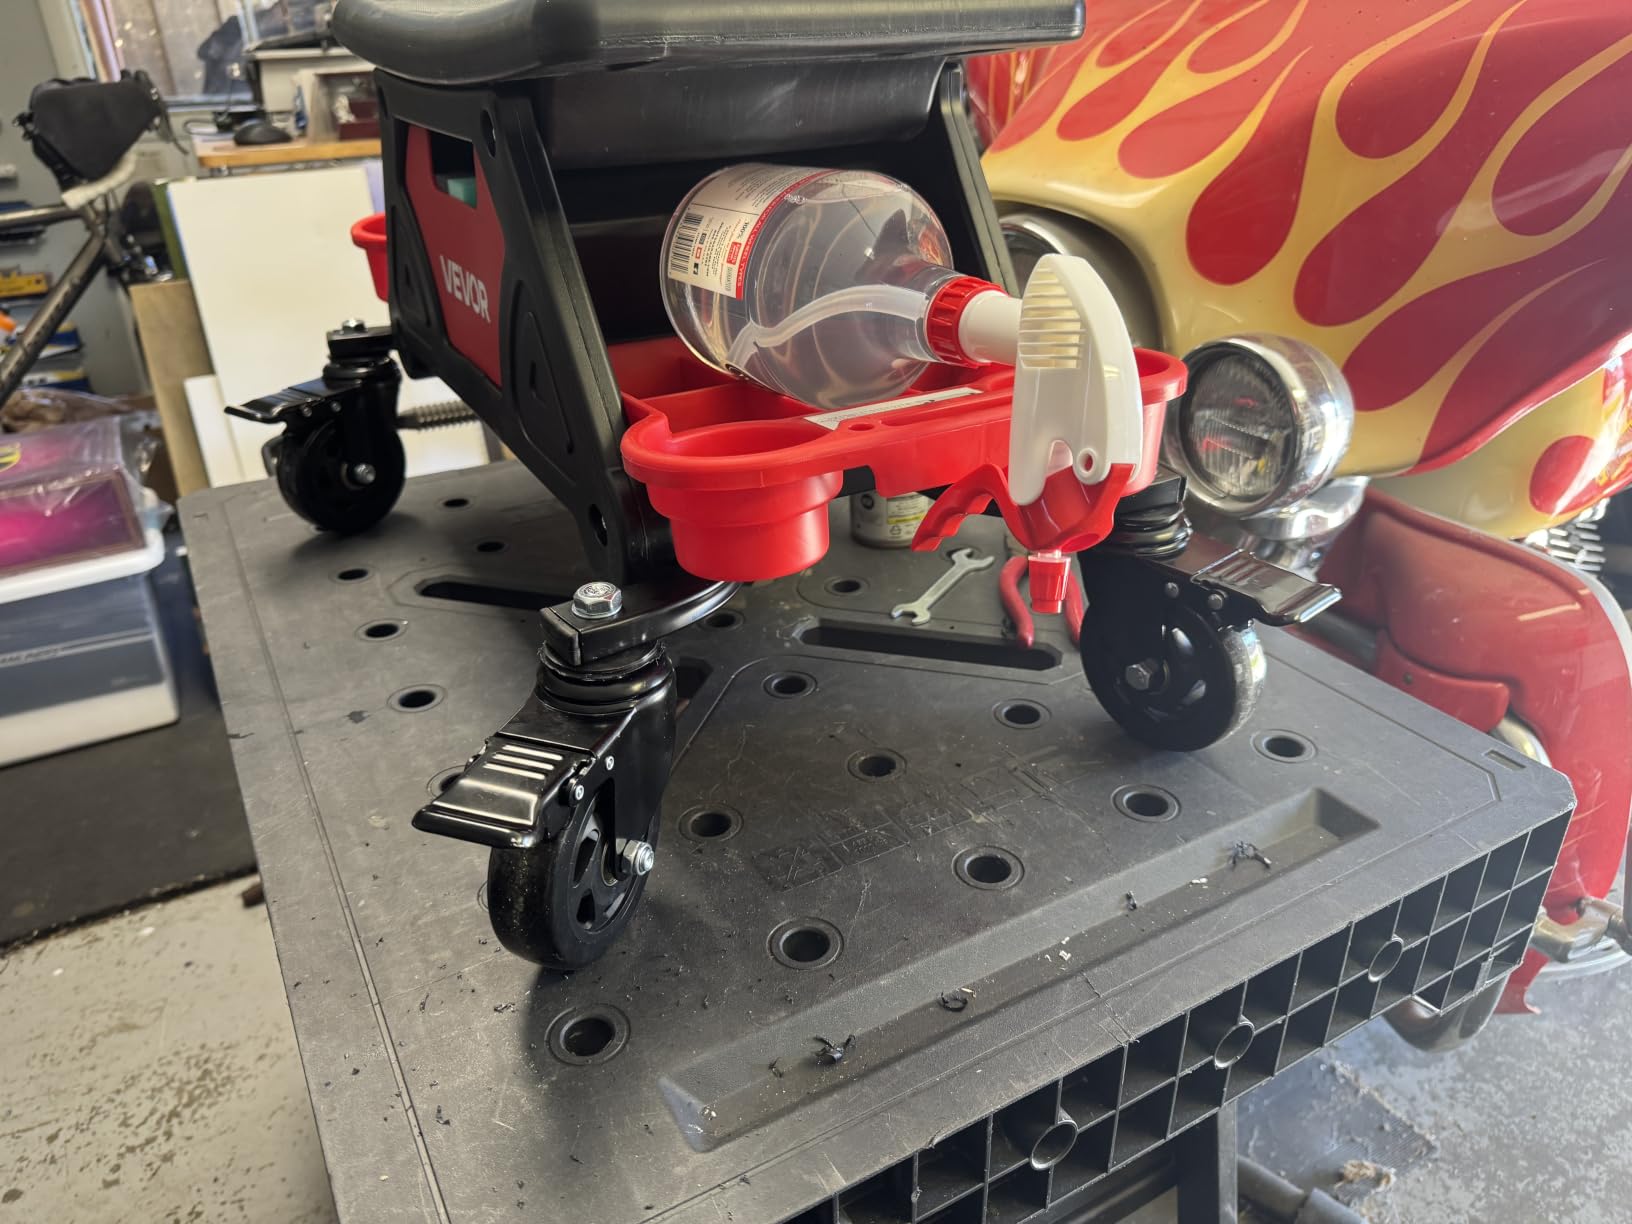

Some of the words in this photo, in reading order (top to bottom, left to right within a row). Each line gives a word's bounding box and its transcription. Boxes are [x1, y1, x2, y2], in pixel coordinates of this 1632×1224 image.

[742, 233, 754, 260] WHEEL
[737, 261, 745, 287] TYPES
[439, 254, 491, 324] VEVOR
